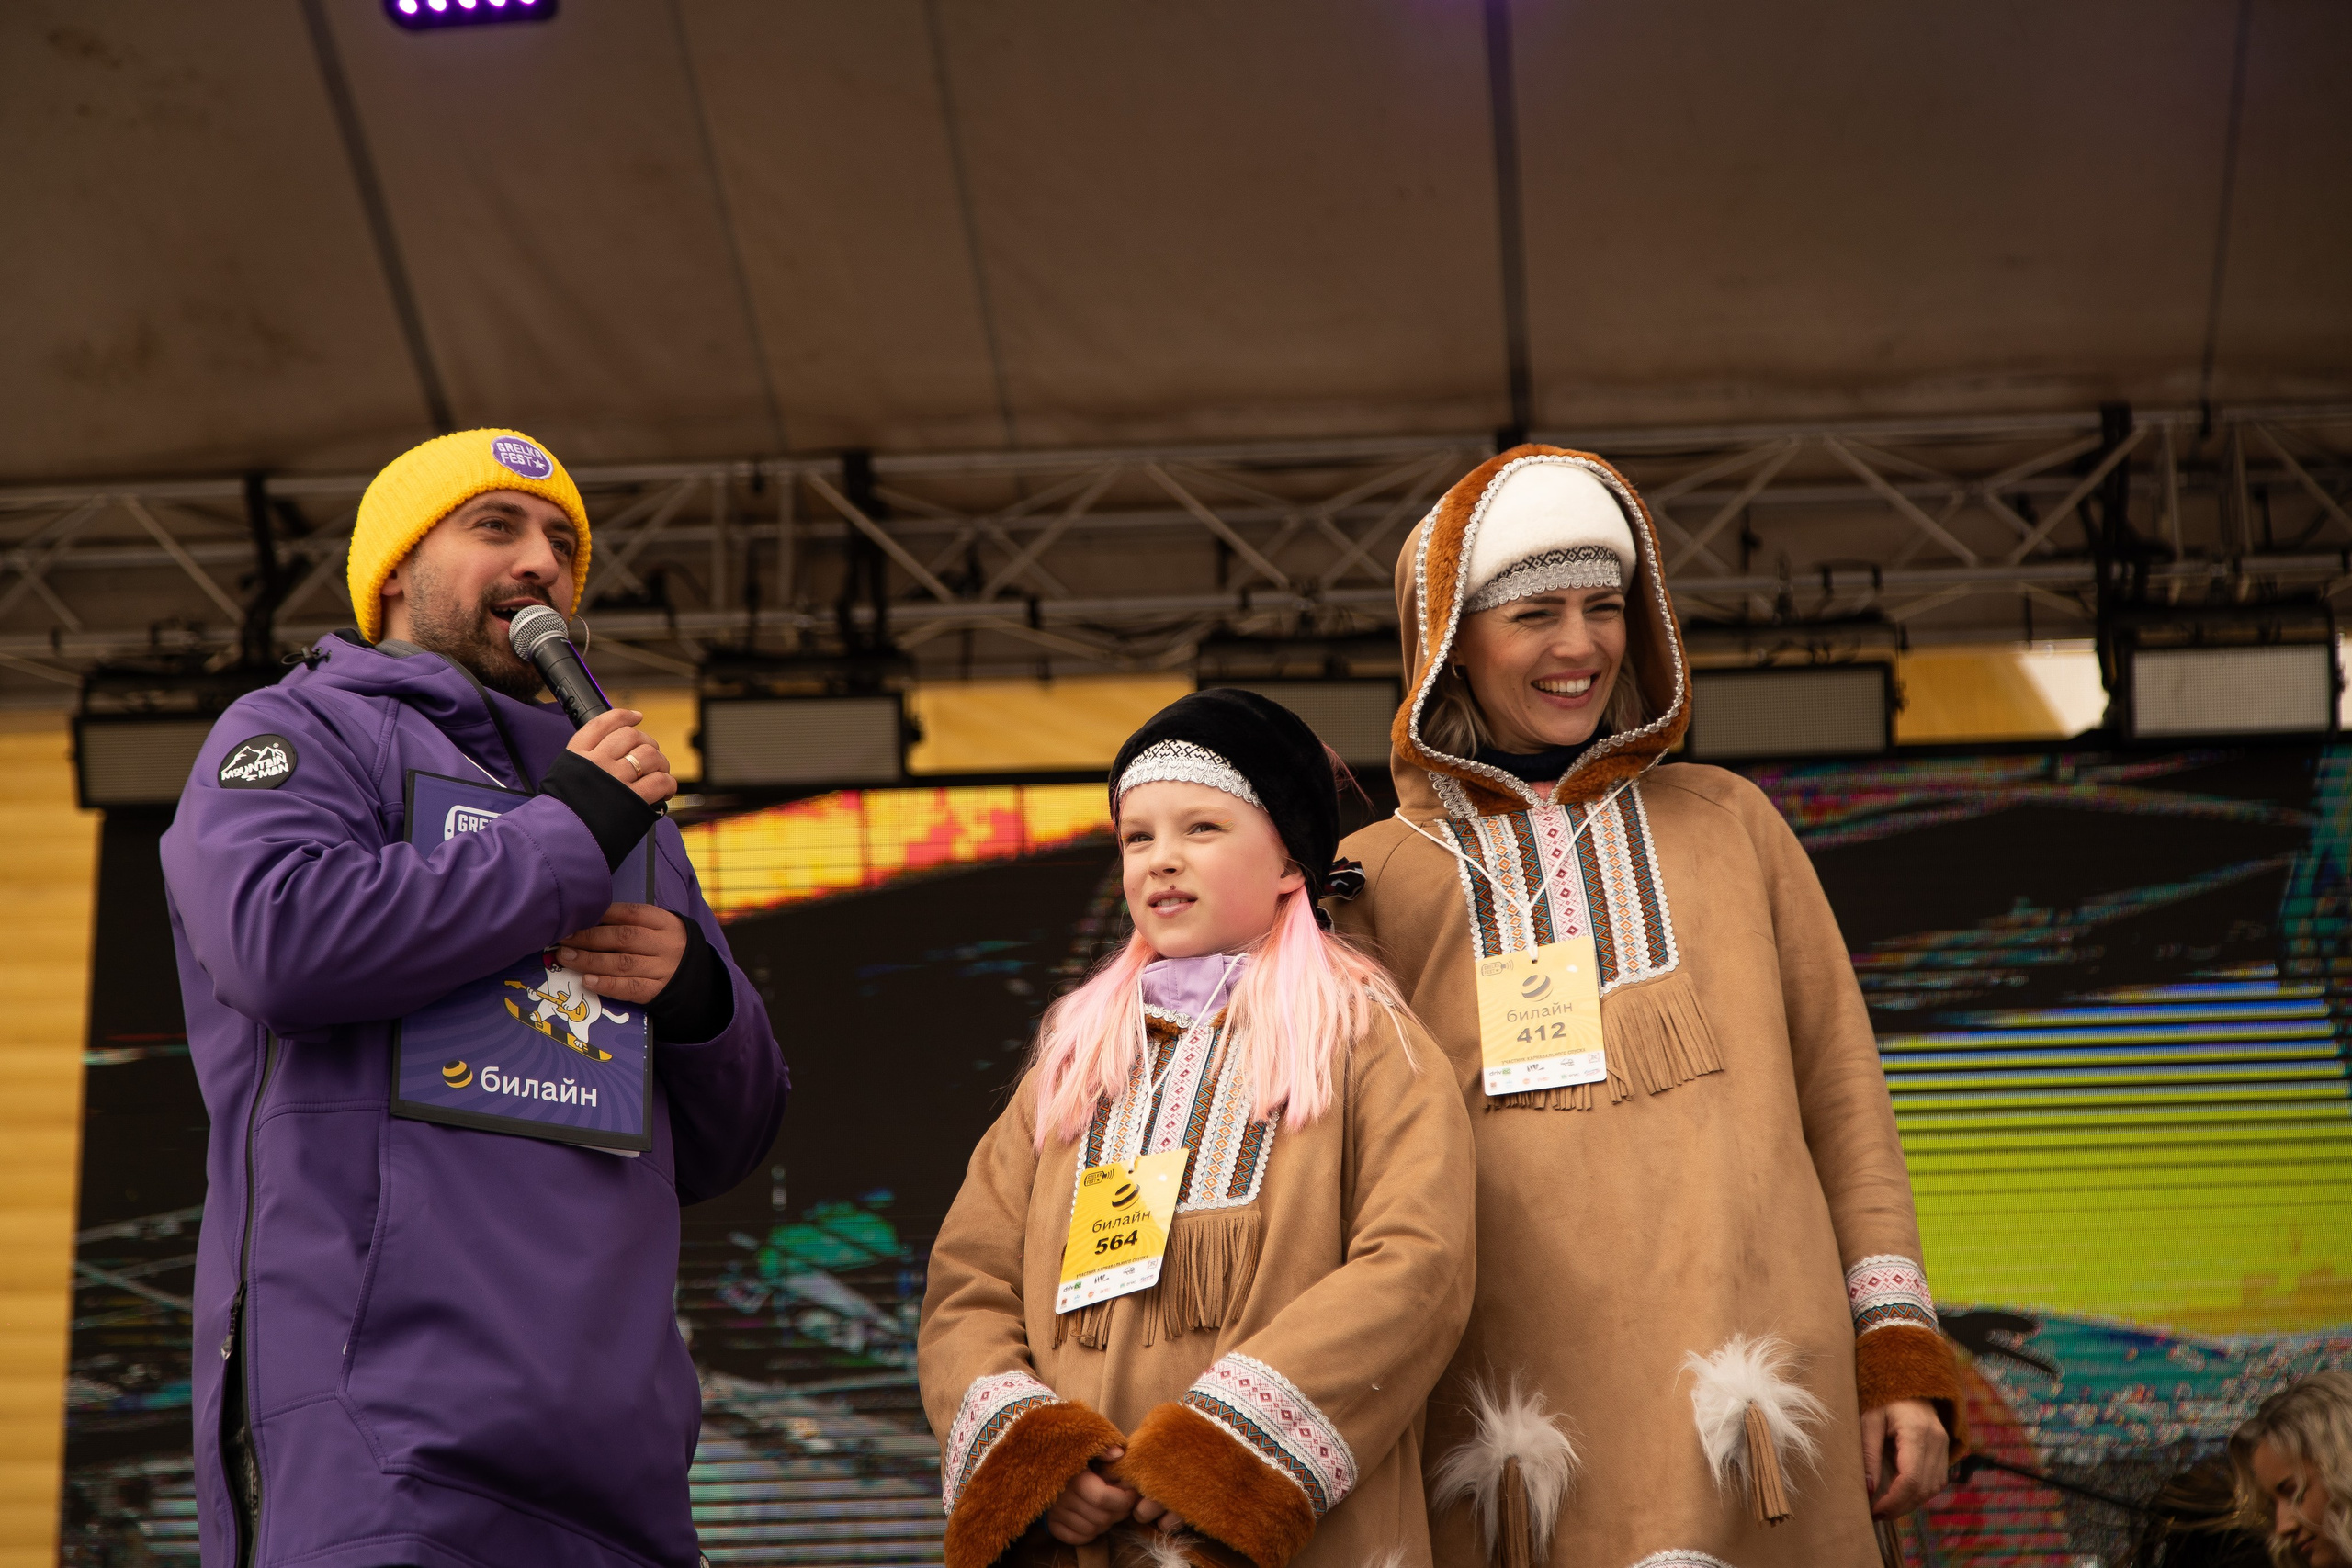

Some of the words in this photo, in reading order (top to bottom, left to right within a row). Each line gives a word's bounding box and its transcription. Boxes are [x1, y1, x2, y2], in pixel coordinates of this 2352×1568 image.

[496, 442, 543, 460] GRELKA
[500, 452, 534, 467] FEST
[220, 755, 288, 781] MOUNTAIN
[258, 762, 289, 779] MAN
[458, 813, 492, 833] GRE
[1506, 1002, 1573, 1023] билайн
[1516, 1021, 1566, 1043] 412
[481, 1066, 597, 1108] билайн
[1091, 1210, 1151, 1234] билайн
[1094, 1229, 1138, 1256] 564
